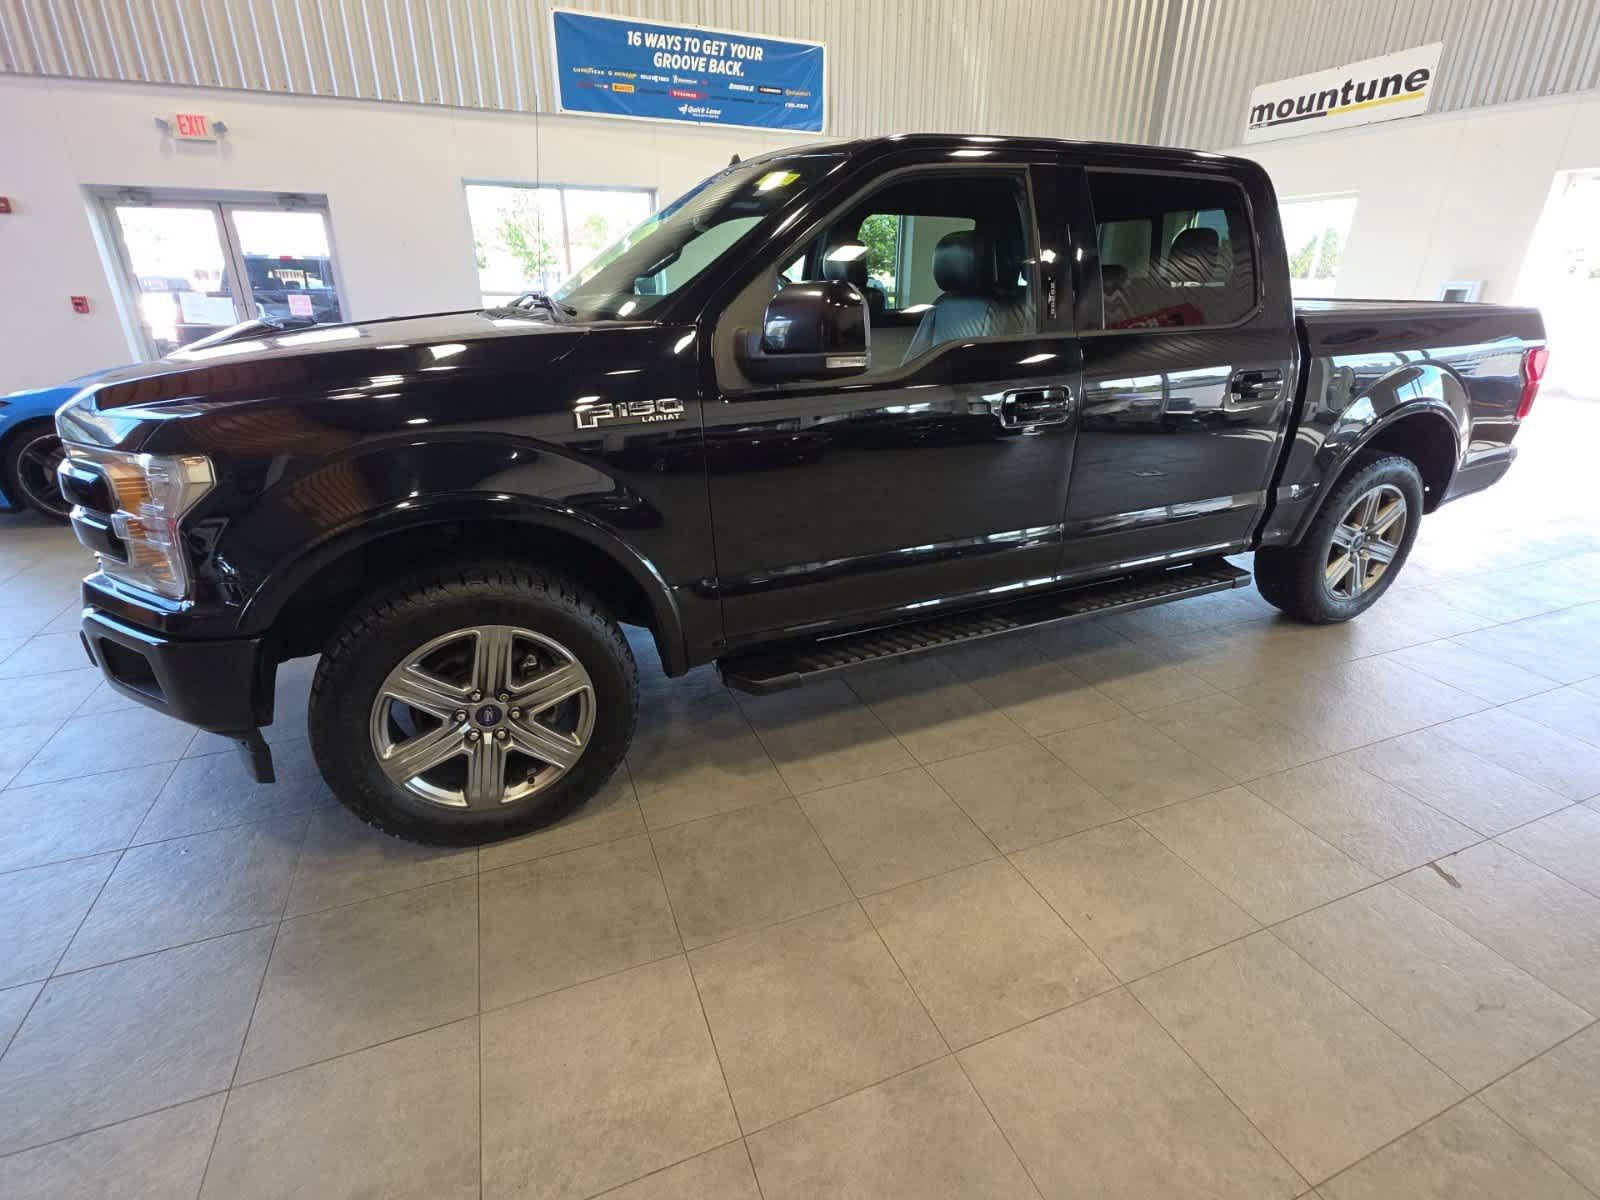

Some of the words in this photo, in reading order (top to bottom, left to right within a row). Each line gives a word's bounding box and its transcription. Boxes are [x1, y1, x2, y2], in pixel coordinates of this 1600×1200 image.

[627, 30, 642, 46] 16
[644, 34, 681, 51] WAYS
[684, 37, 700, 53] TO
[702, 40, 727, 56] GET
[730, 43, 763, 61] YOUR
[653, 51, 707, 73] GROOVE
[709, 57, 744, 77] BACK.
[1249, 68, 1430, 124] mountune
[687, 105, 704, 115] Quick
[176, 114, 207, 136] EXIT
[641, 413, 681, 423] LARIAT
